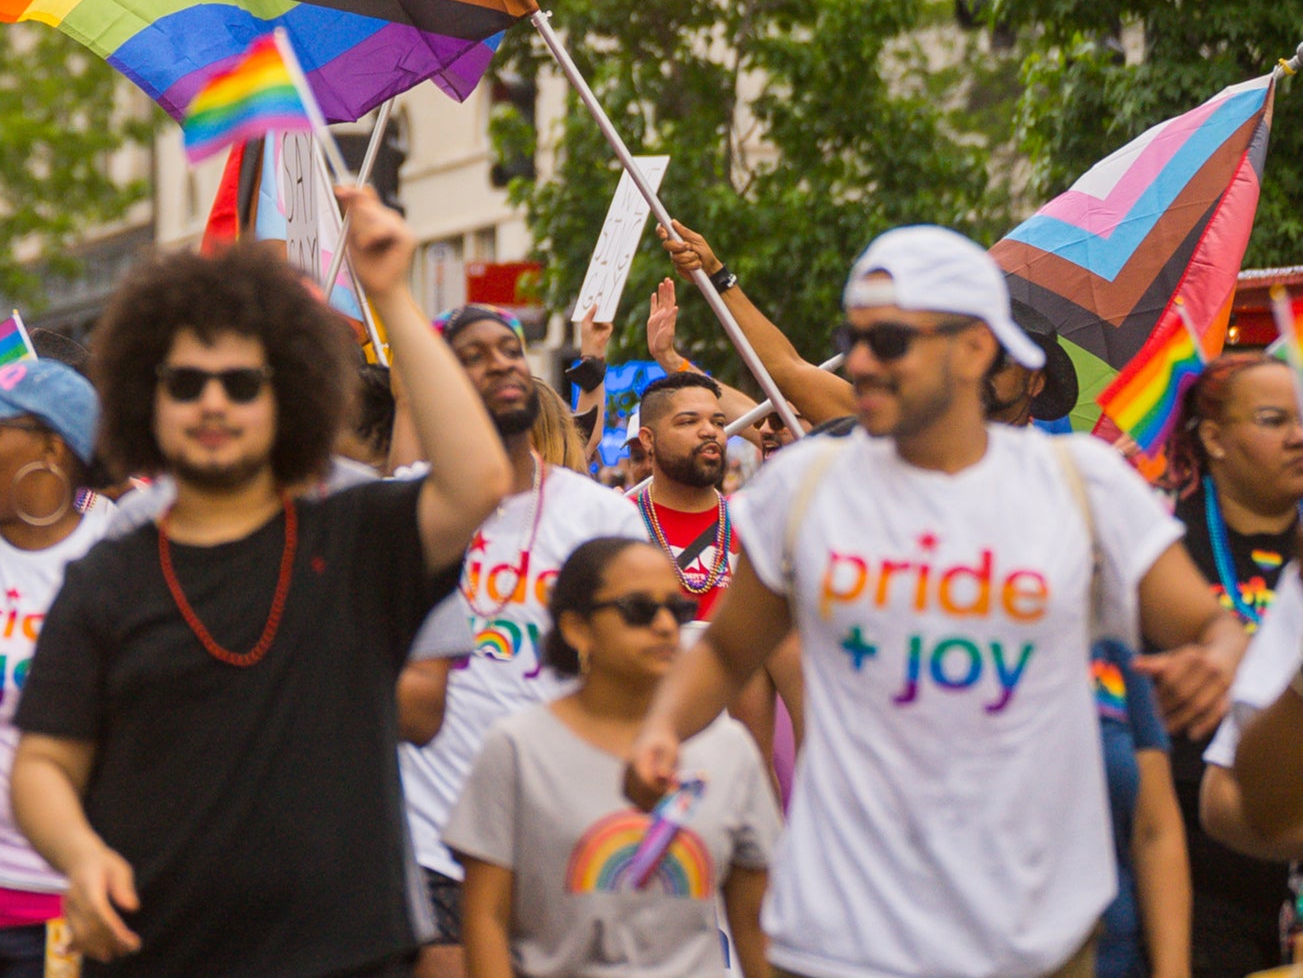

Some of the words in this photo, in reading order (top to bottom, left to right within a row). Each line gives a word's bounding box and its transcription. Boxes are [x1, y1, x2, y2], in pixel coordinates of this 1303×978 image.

[282, 130, 314, 223] SAY
[820, 533, 1050, 624] pride
[842, 625, 878, 671] +
[893, 635, 1035, 714] joy
